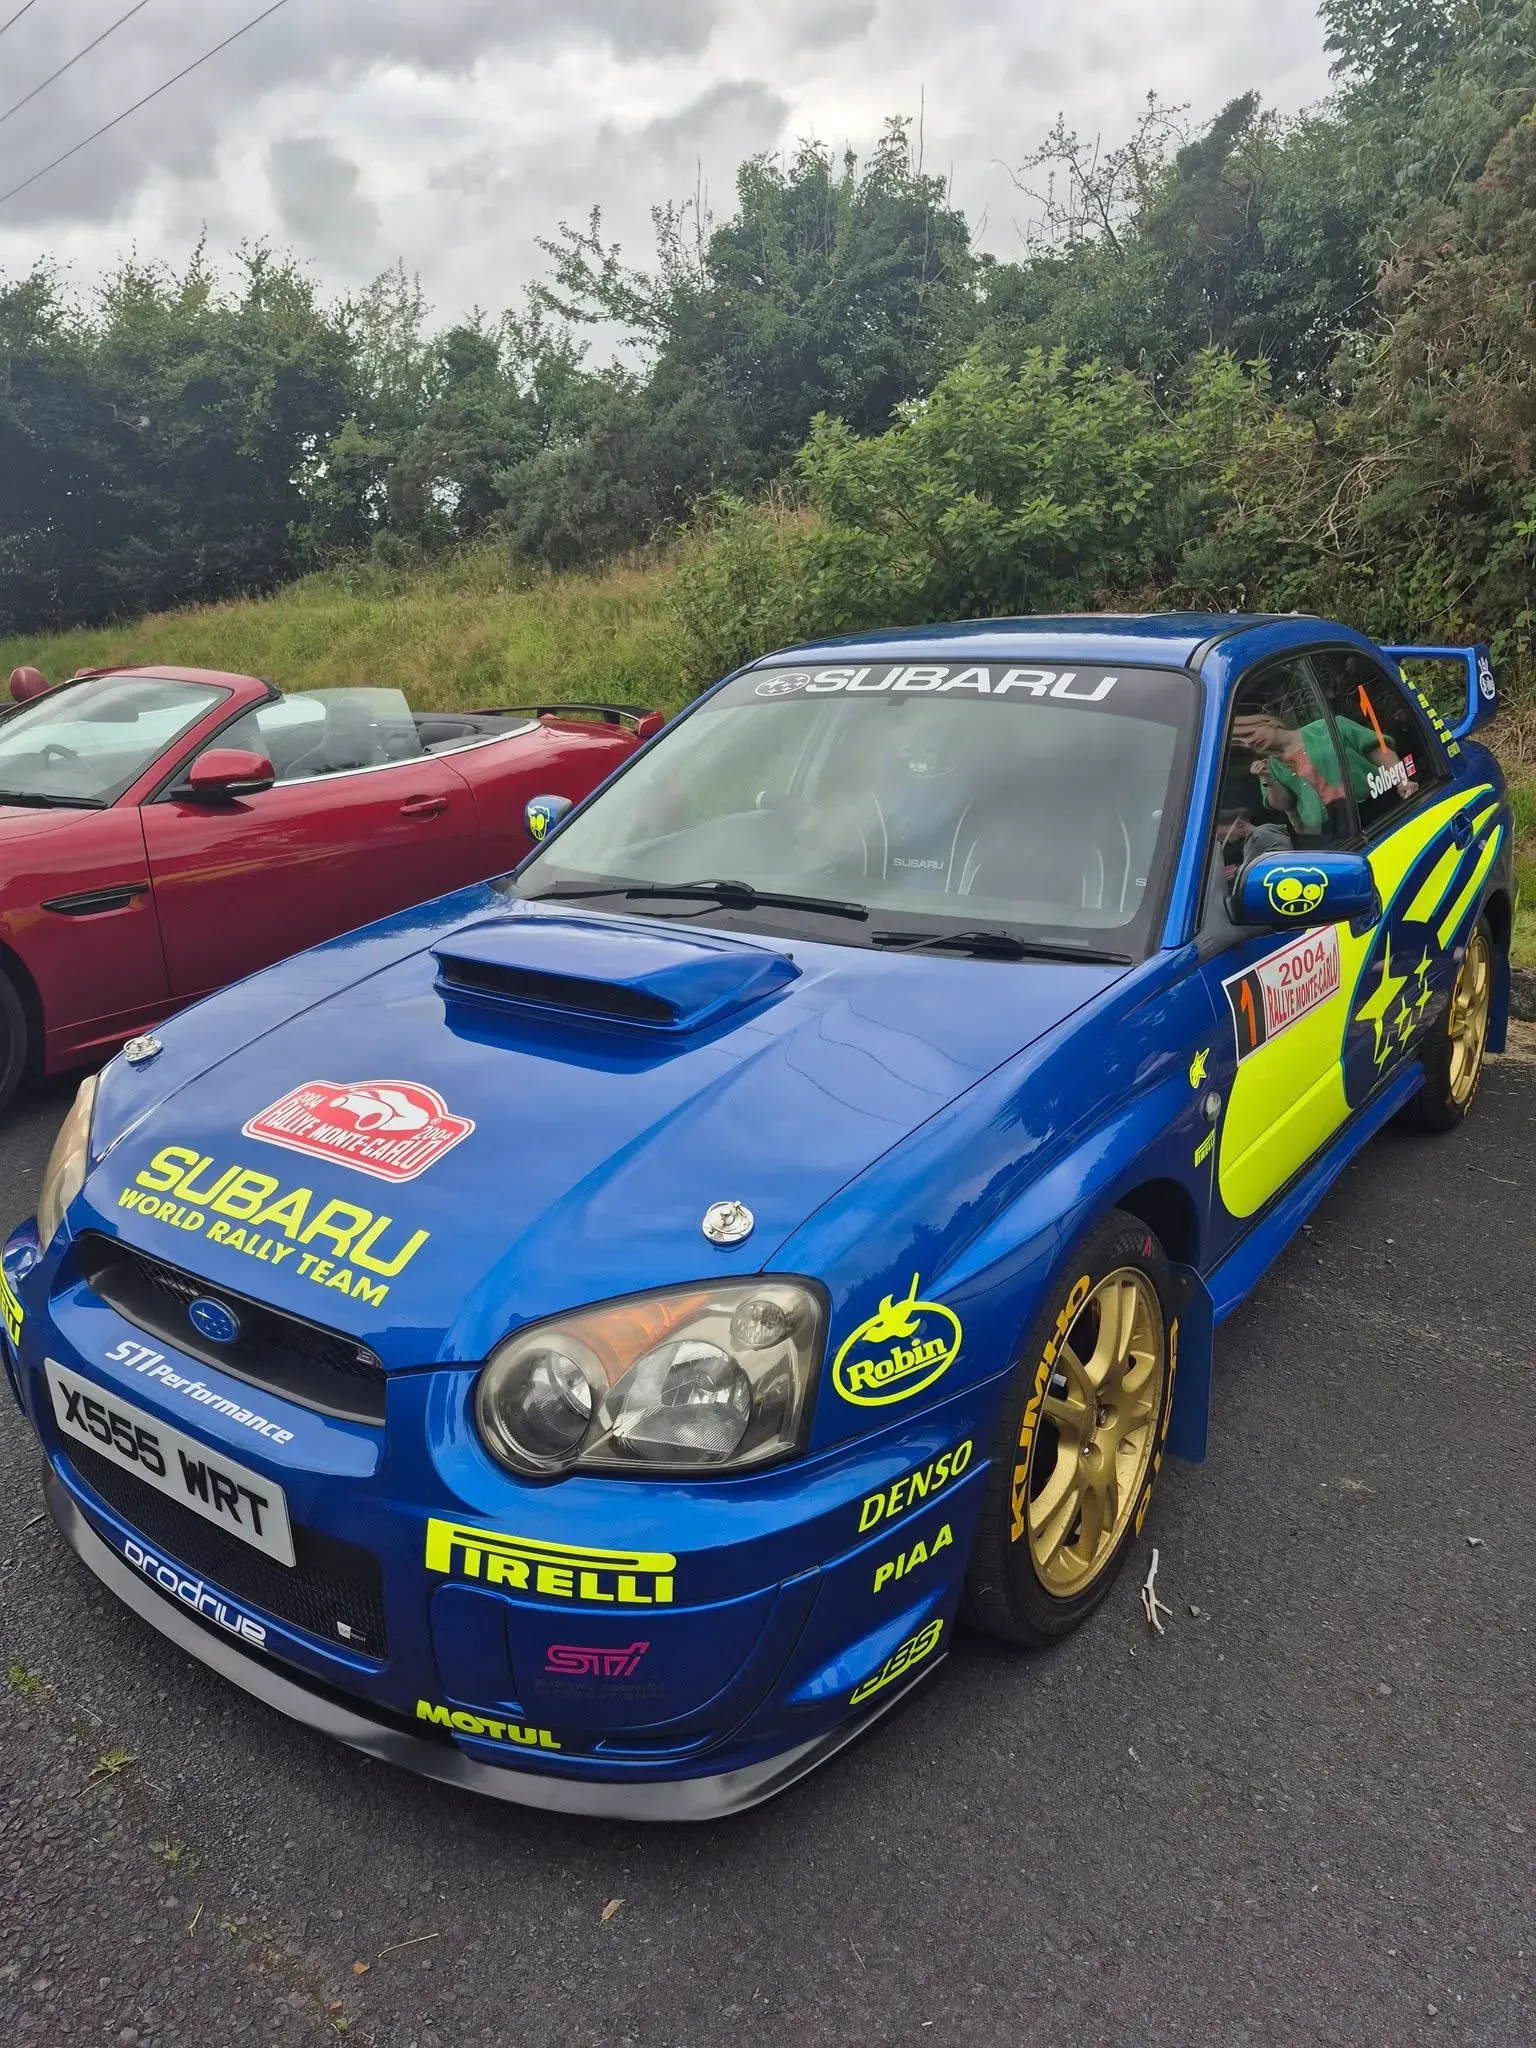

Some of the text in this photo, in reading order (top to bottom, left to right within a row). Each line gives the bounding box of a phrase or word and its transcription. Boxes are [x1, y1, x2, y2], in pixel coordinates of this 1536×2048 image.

[804, 666, 1119, 702] SUBARU
[1366, 760, 1408, 799] Solberg
[892, 858, 944, 869] SUBARU
[1278, 940, 1326, 987] 2004
[1240, 979, 1257, 1047] 1
[1266, 984, 1296, 1030] RALLYE
[298, 1090, 329, 1109] 2004
[259, 1100, 443, 1170] RALLYE MONTE-CARLO
[411, 1126, 455, 1142] 2004
[135, 1146, 430, 1277] SUBARU
[118, 1188, 390, 1308] WORLD RALLY TEAM
[846, 1338, 948, 1393] Robin
[1011, 1274, 1091, 1543] KUMHO
[57, 1381, 269, 1536] X555 WRT
[858, 1440, 973, 1533] DENSO
[425, 1518, 677, 1603] PIRELLI
[873, 1523, 952, 1593] PIAA
[124, 1539, 267, 1647] prodrive
[415, 1699, 562, 1749] MOTUL
